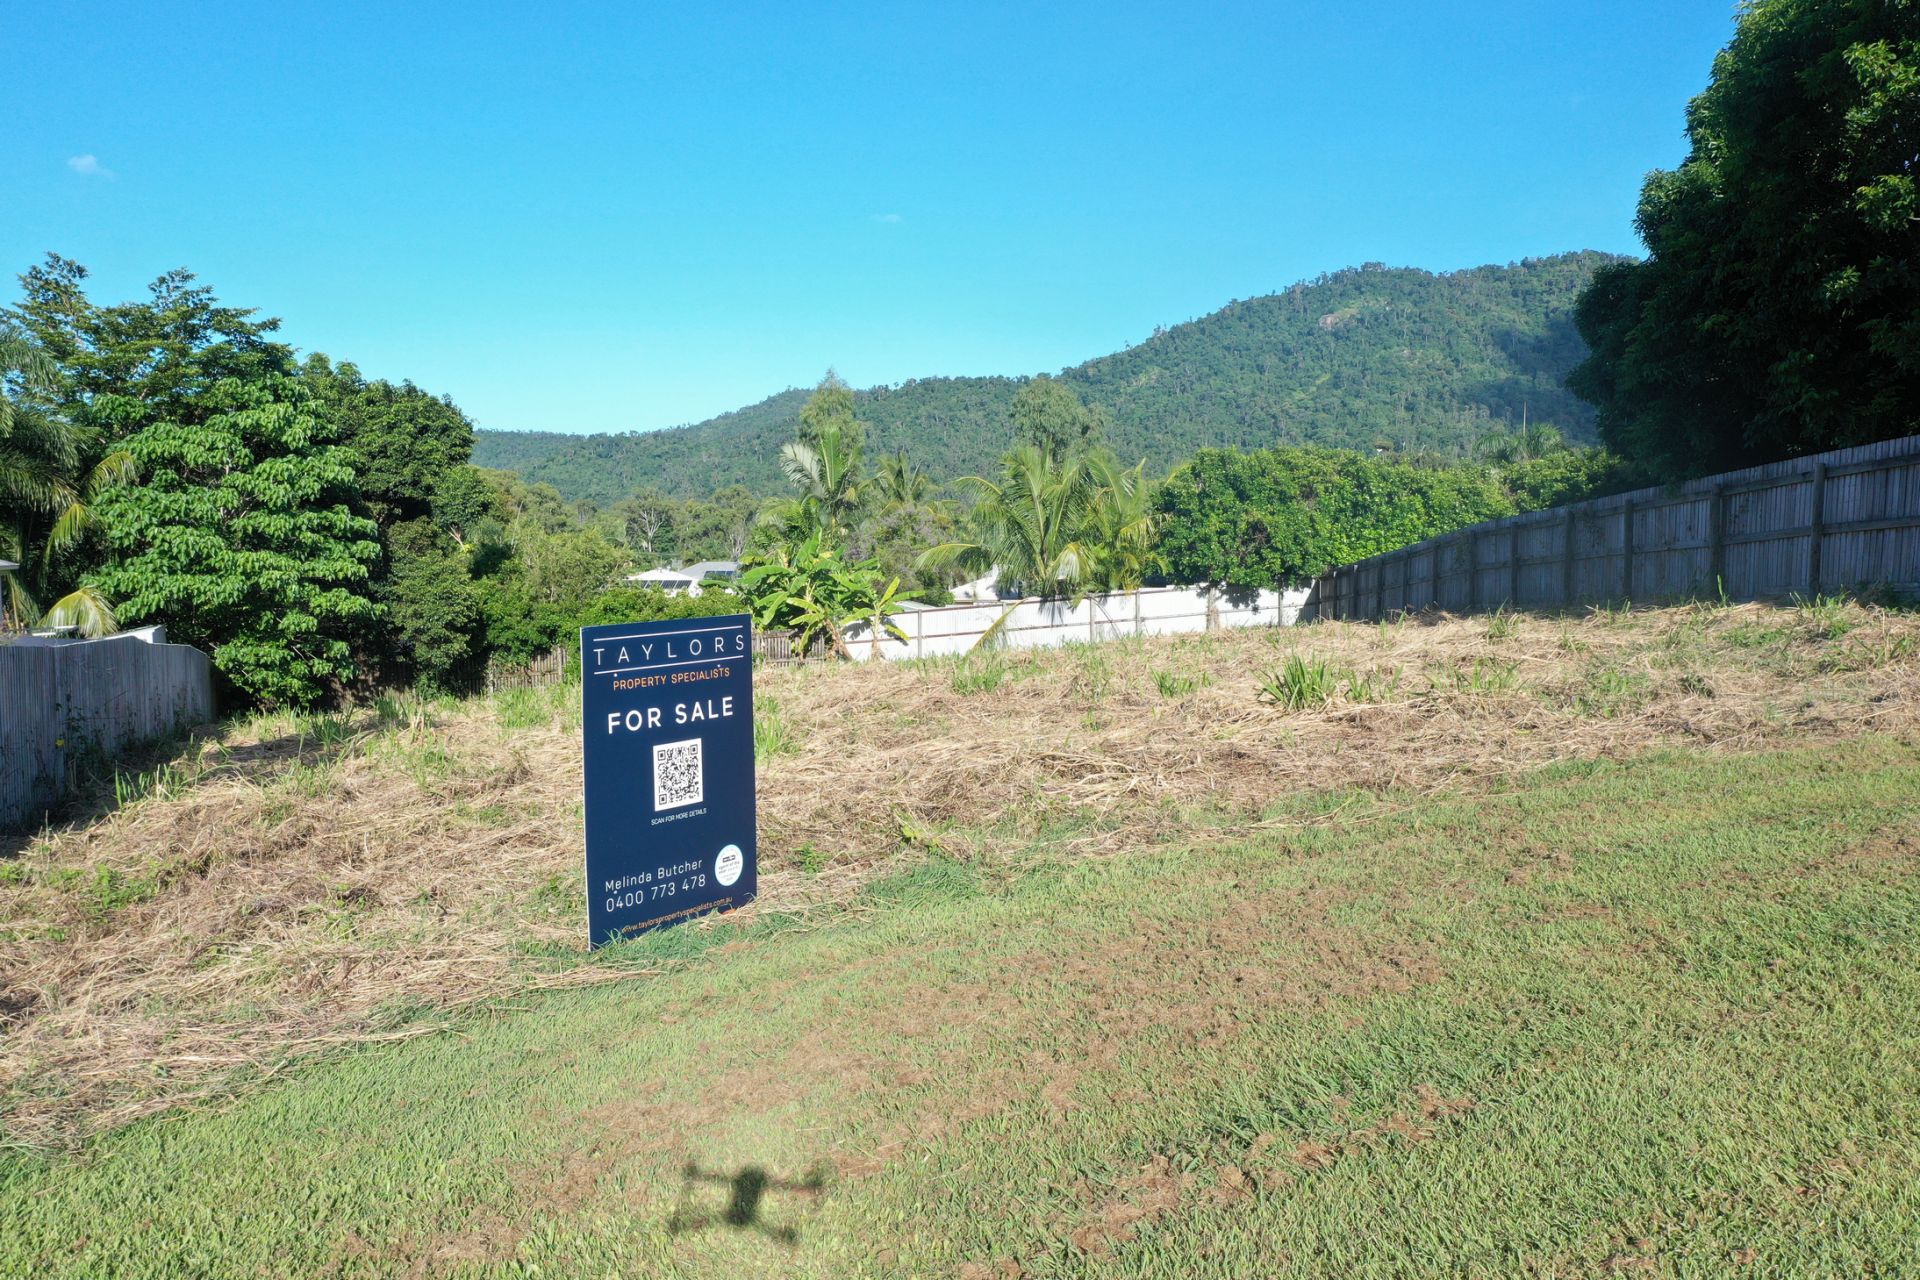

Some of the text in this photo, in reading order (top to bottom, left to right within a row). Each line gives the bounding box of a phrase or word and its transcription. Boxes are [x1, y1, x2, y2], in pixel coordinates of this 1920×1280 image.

[593, 634, 744, 665] TAYLORS
[613, 667, 730, 691] PROPERTY SPECIALISTS
[608, 696, 733, 734] FOR SALE
[651, 807, 707, 826] SCAN FOR MORE DETAILS
[605, 871, 652, 893] Melinda
[658, 859, 703, 880] Butcher
[606, 890, 644, 912] 0400
[651, 882, 676, 901] 773
[682, 874, 706, 892] 478
